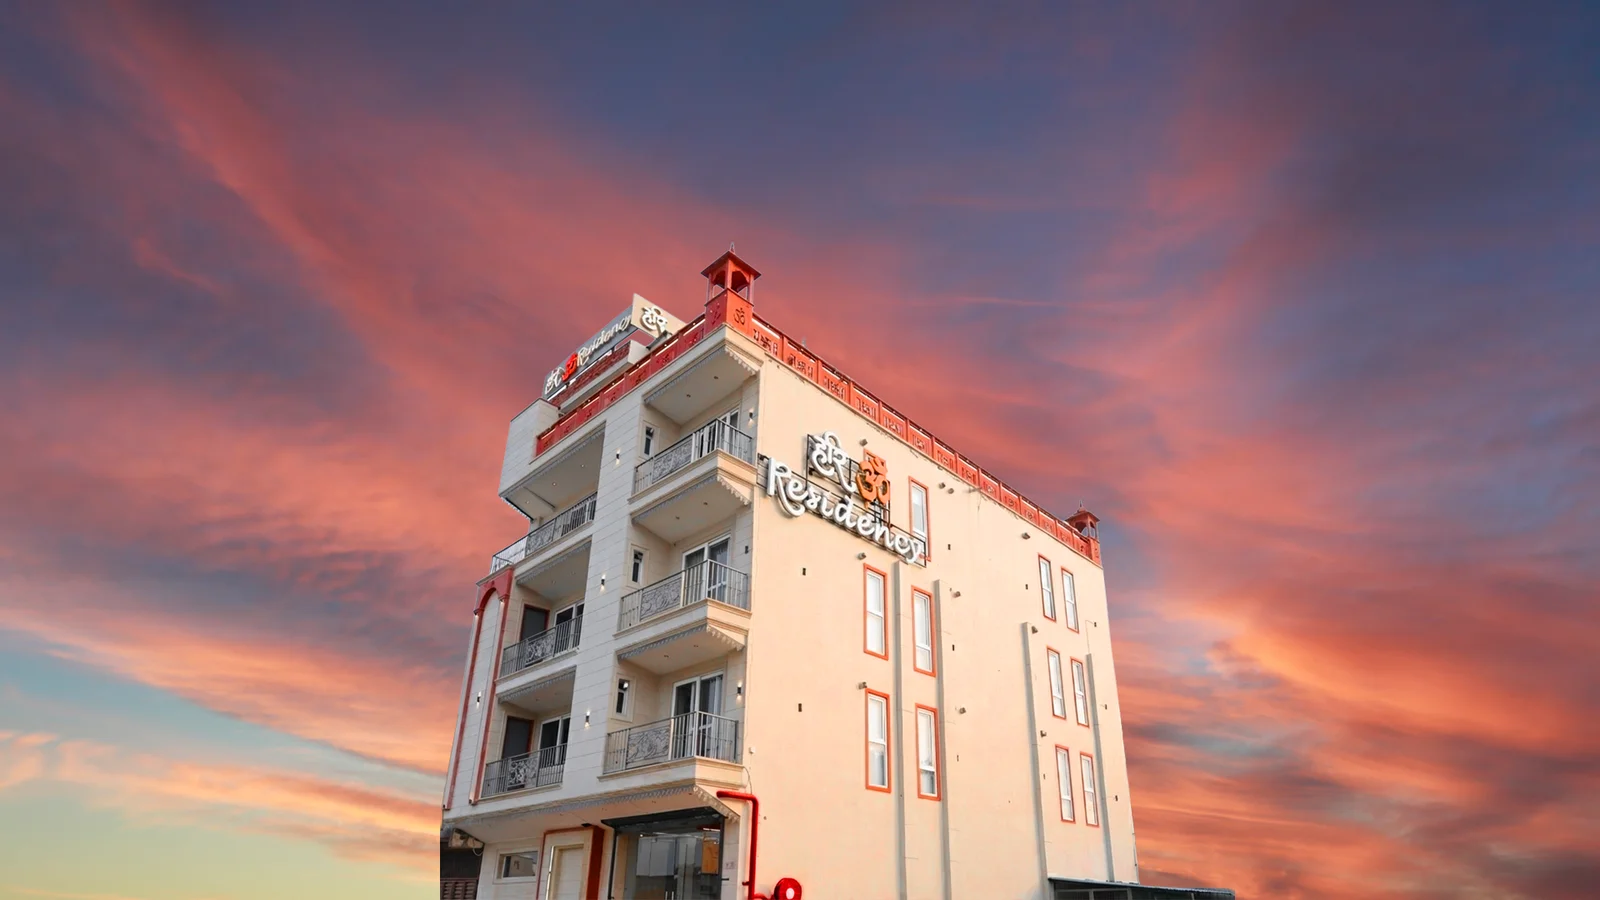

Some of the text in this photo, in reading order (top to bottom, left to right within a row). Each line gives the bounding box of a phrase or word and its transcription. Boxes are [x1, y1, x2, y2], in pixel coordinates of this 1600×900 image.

[576, 315, 632, 367] Residency
[810, 430, 857, 494] हरि
[766, 456, 923, 565] Residency
